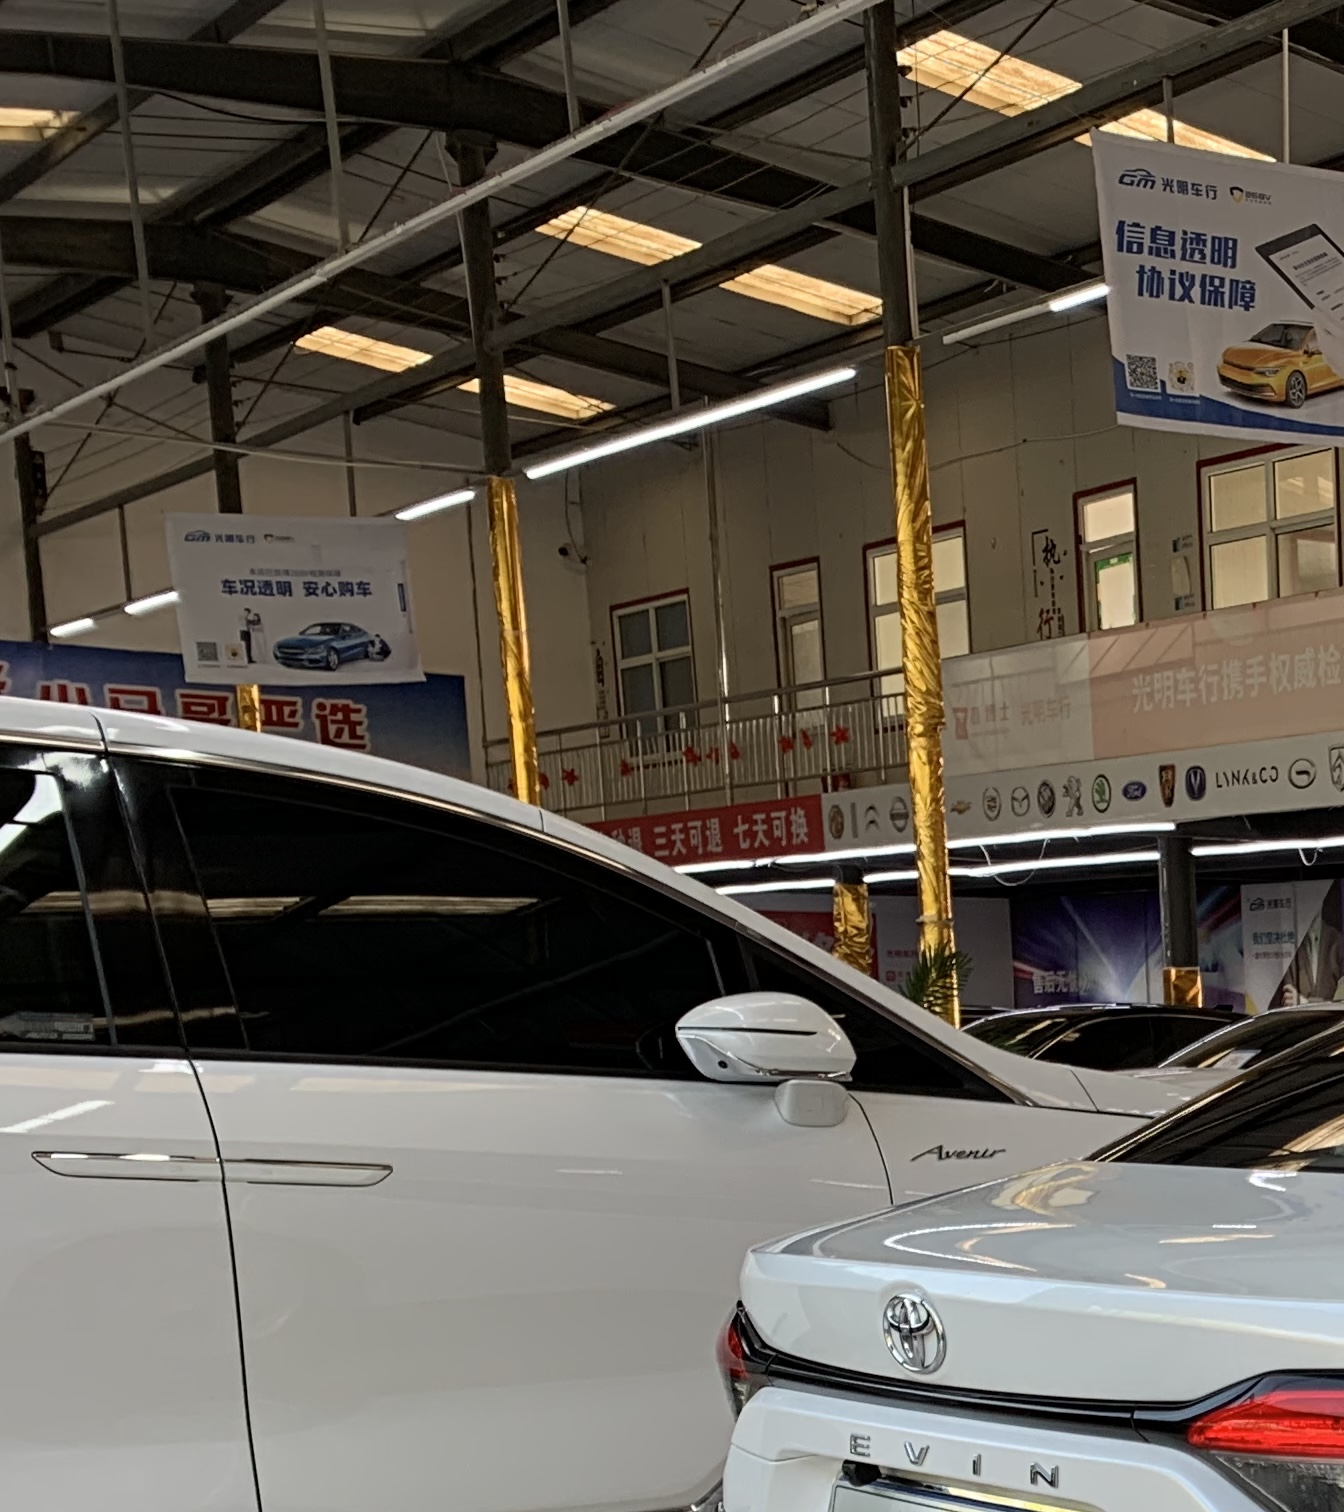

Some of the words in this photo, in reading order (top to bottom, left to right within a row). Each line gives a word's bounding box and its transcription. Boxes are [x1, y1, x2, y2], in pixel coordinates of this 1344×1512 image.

[1161, 177, 1217, 200] 光明车行
[1116, 220, 1238, 269] 信息透明
[1136, 264, 1256, 311] 协议保障
[221, 578, 293, 598] 车况透明
[303, 580, 372, 598] 安心购车
[653, 817, 723, 858] 三天可退
[734, 807, 809, 850] 七天可换
[910, 1144, 1006, 1162] Avenir
[849, 1432, 1060, 1489] EVIN
